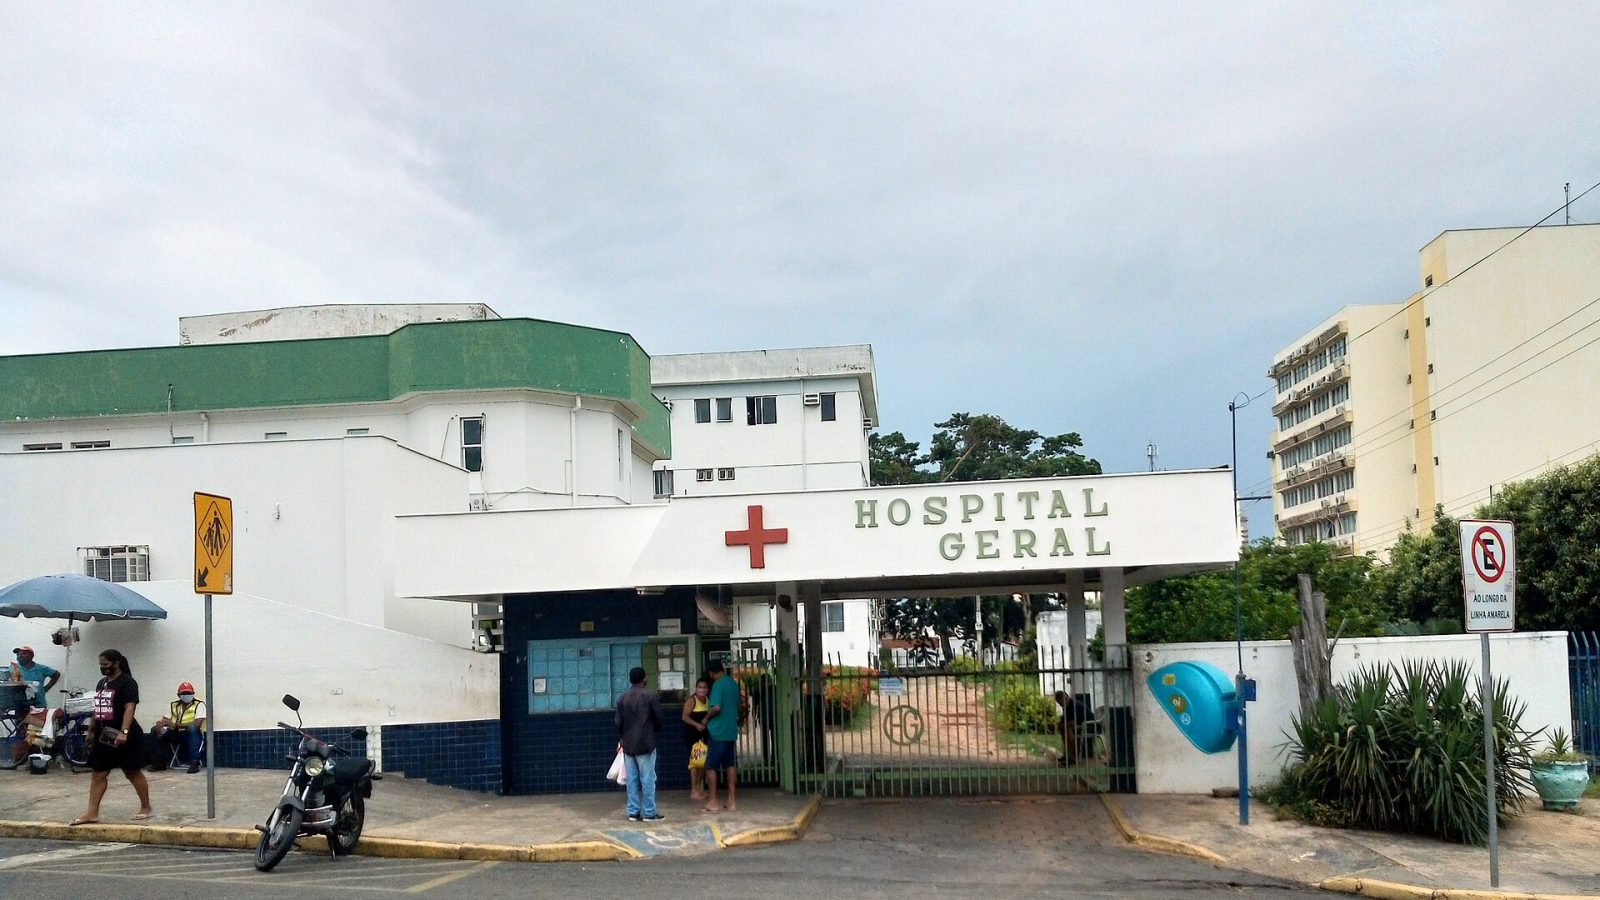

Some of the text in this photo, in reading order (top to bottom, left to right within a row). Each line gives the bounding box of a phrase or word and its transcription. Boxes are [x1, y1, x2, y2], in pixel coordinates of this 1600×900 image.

[855, 488, 1108, 528] HOSPITAL
[939, 527, 1111, 561] GERAL
[1482, 538, 1496, 570] E
[1470, 610, 1510, 619] LINHA AMARELA
[1473, 594, 1508, 603] AO LONGO DA
